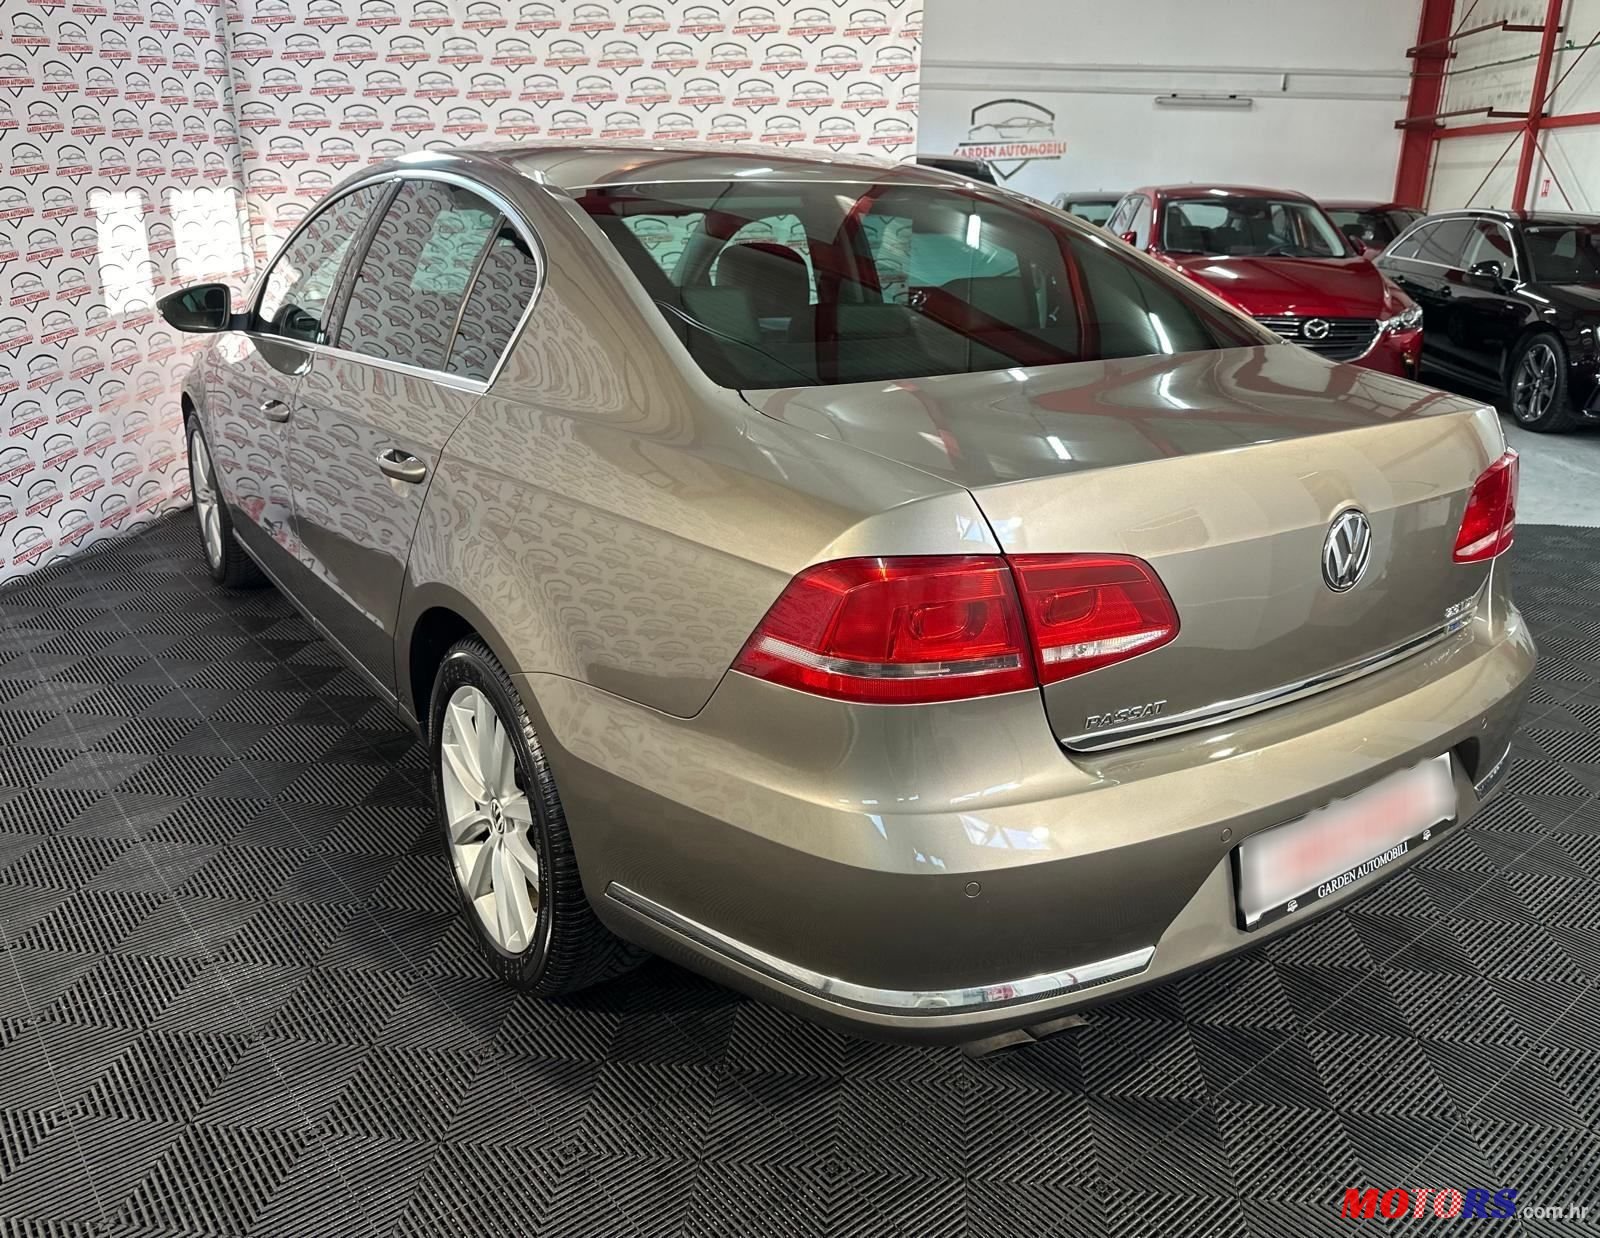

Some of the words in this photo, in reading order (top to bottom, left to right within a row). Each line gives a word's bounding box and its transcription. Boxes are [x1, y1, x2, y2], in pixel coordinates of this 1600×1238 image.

[999, 141, 1067, 156] AUTOMOBILI
[1084, 700, 1168, 729] PASSAT
[1317, 870, 1356, 898] GARDEN
[1357, 842, 1409, 879] AUTOMOBILI
